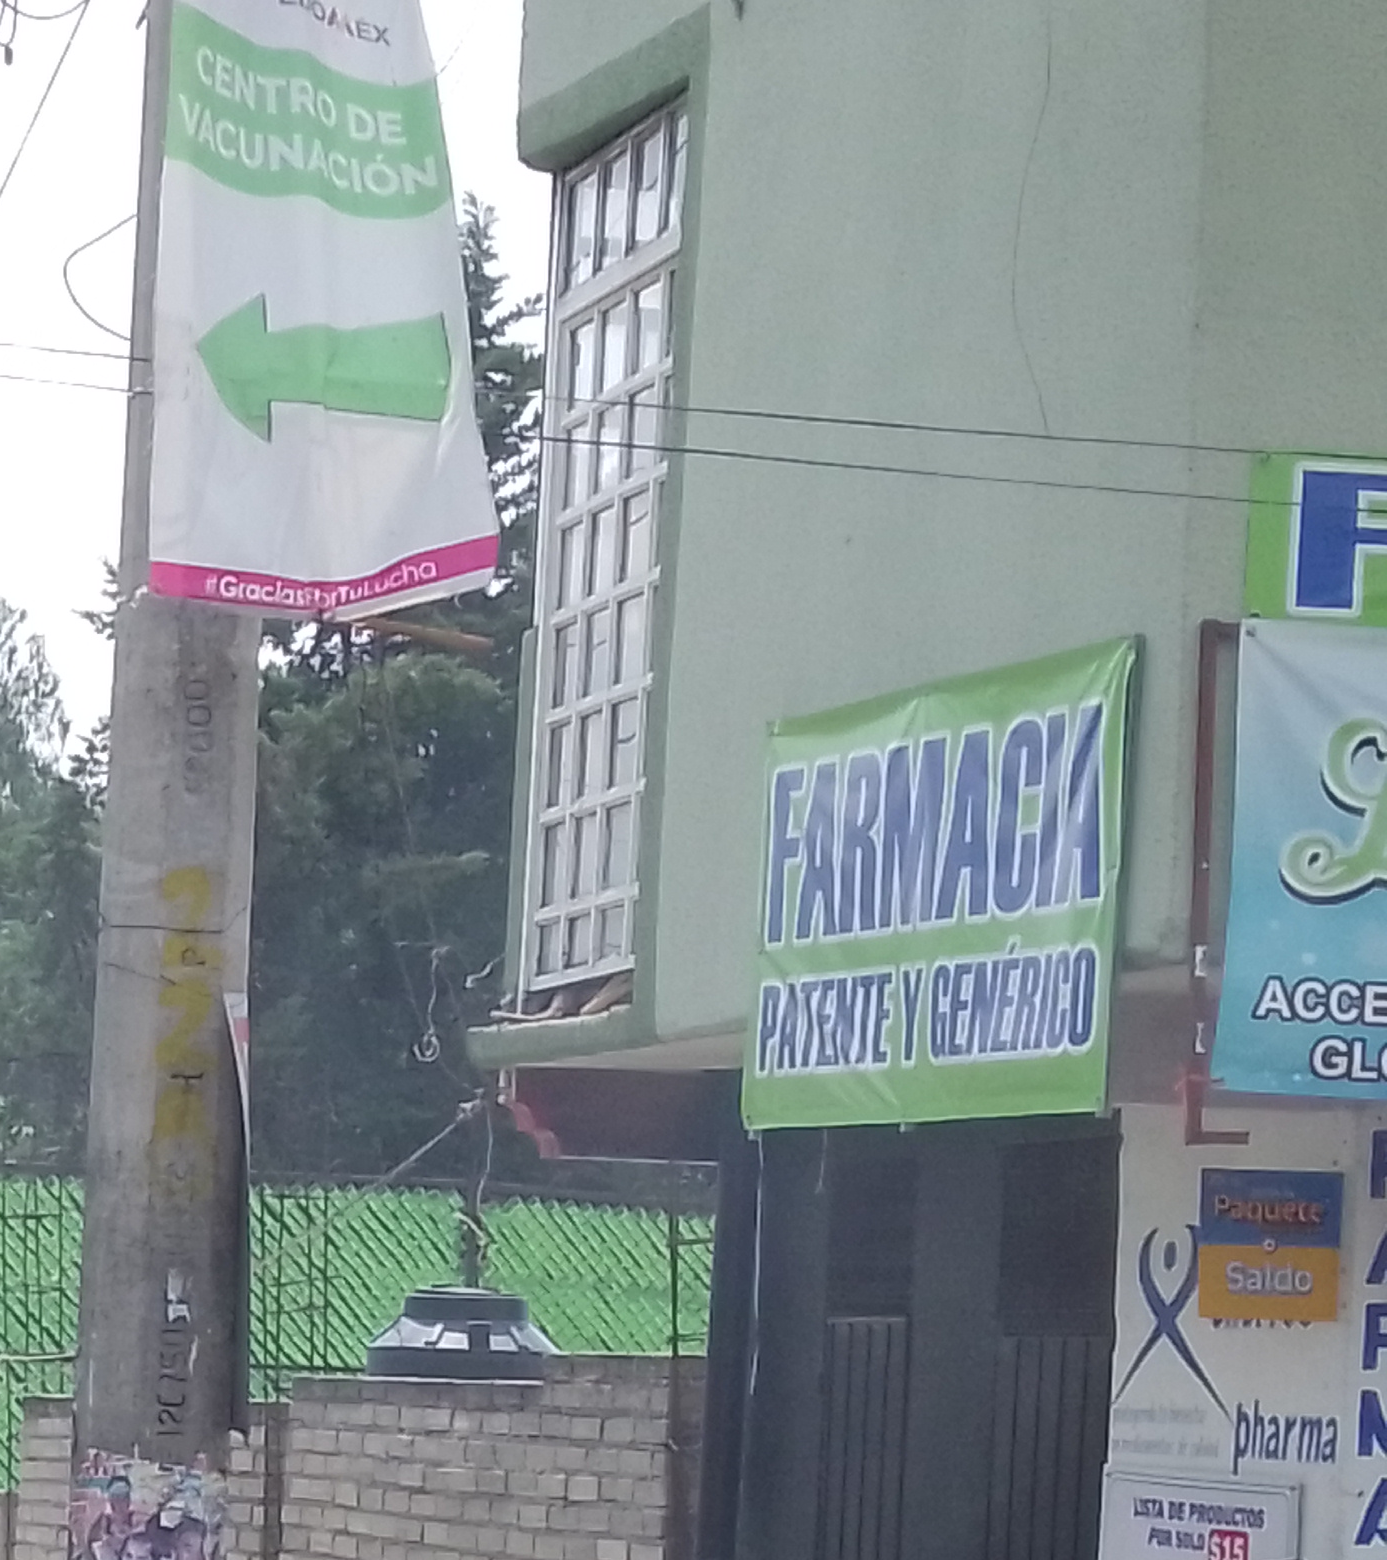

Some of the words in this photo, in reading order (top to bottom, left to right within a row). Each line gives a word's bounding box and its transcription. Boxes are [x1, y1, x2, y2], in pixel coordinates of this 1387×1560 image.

[279, 0, 390, 46] DOMEX
[196, 45, 337, 127] CENTRO
[346, 102, 407, 145] DE
[179, 92, 439, 196] VACUNACIÓN
[765, 700, 1105, 946] FARMACIA
[758, 970, 893, 1074] PATENTE
[900, 966, 925, 1062] Y
[929, 940, 1097, 1061] GENÉRICO
[1310, 1036, 1387, 1080] GL
[1225, 1261, 1314, 1294] Saldo
[1232, 1399, 1338, 1476] pharma
[1133, 1497, 1165, 1519] LISTA
[1168, 1500, 1187, 1521] DE
[1188, 1502, 1266, 1528] PRODUCTOS
